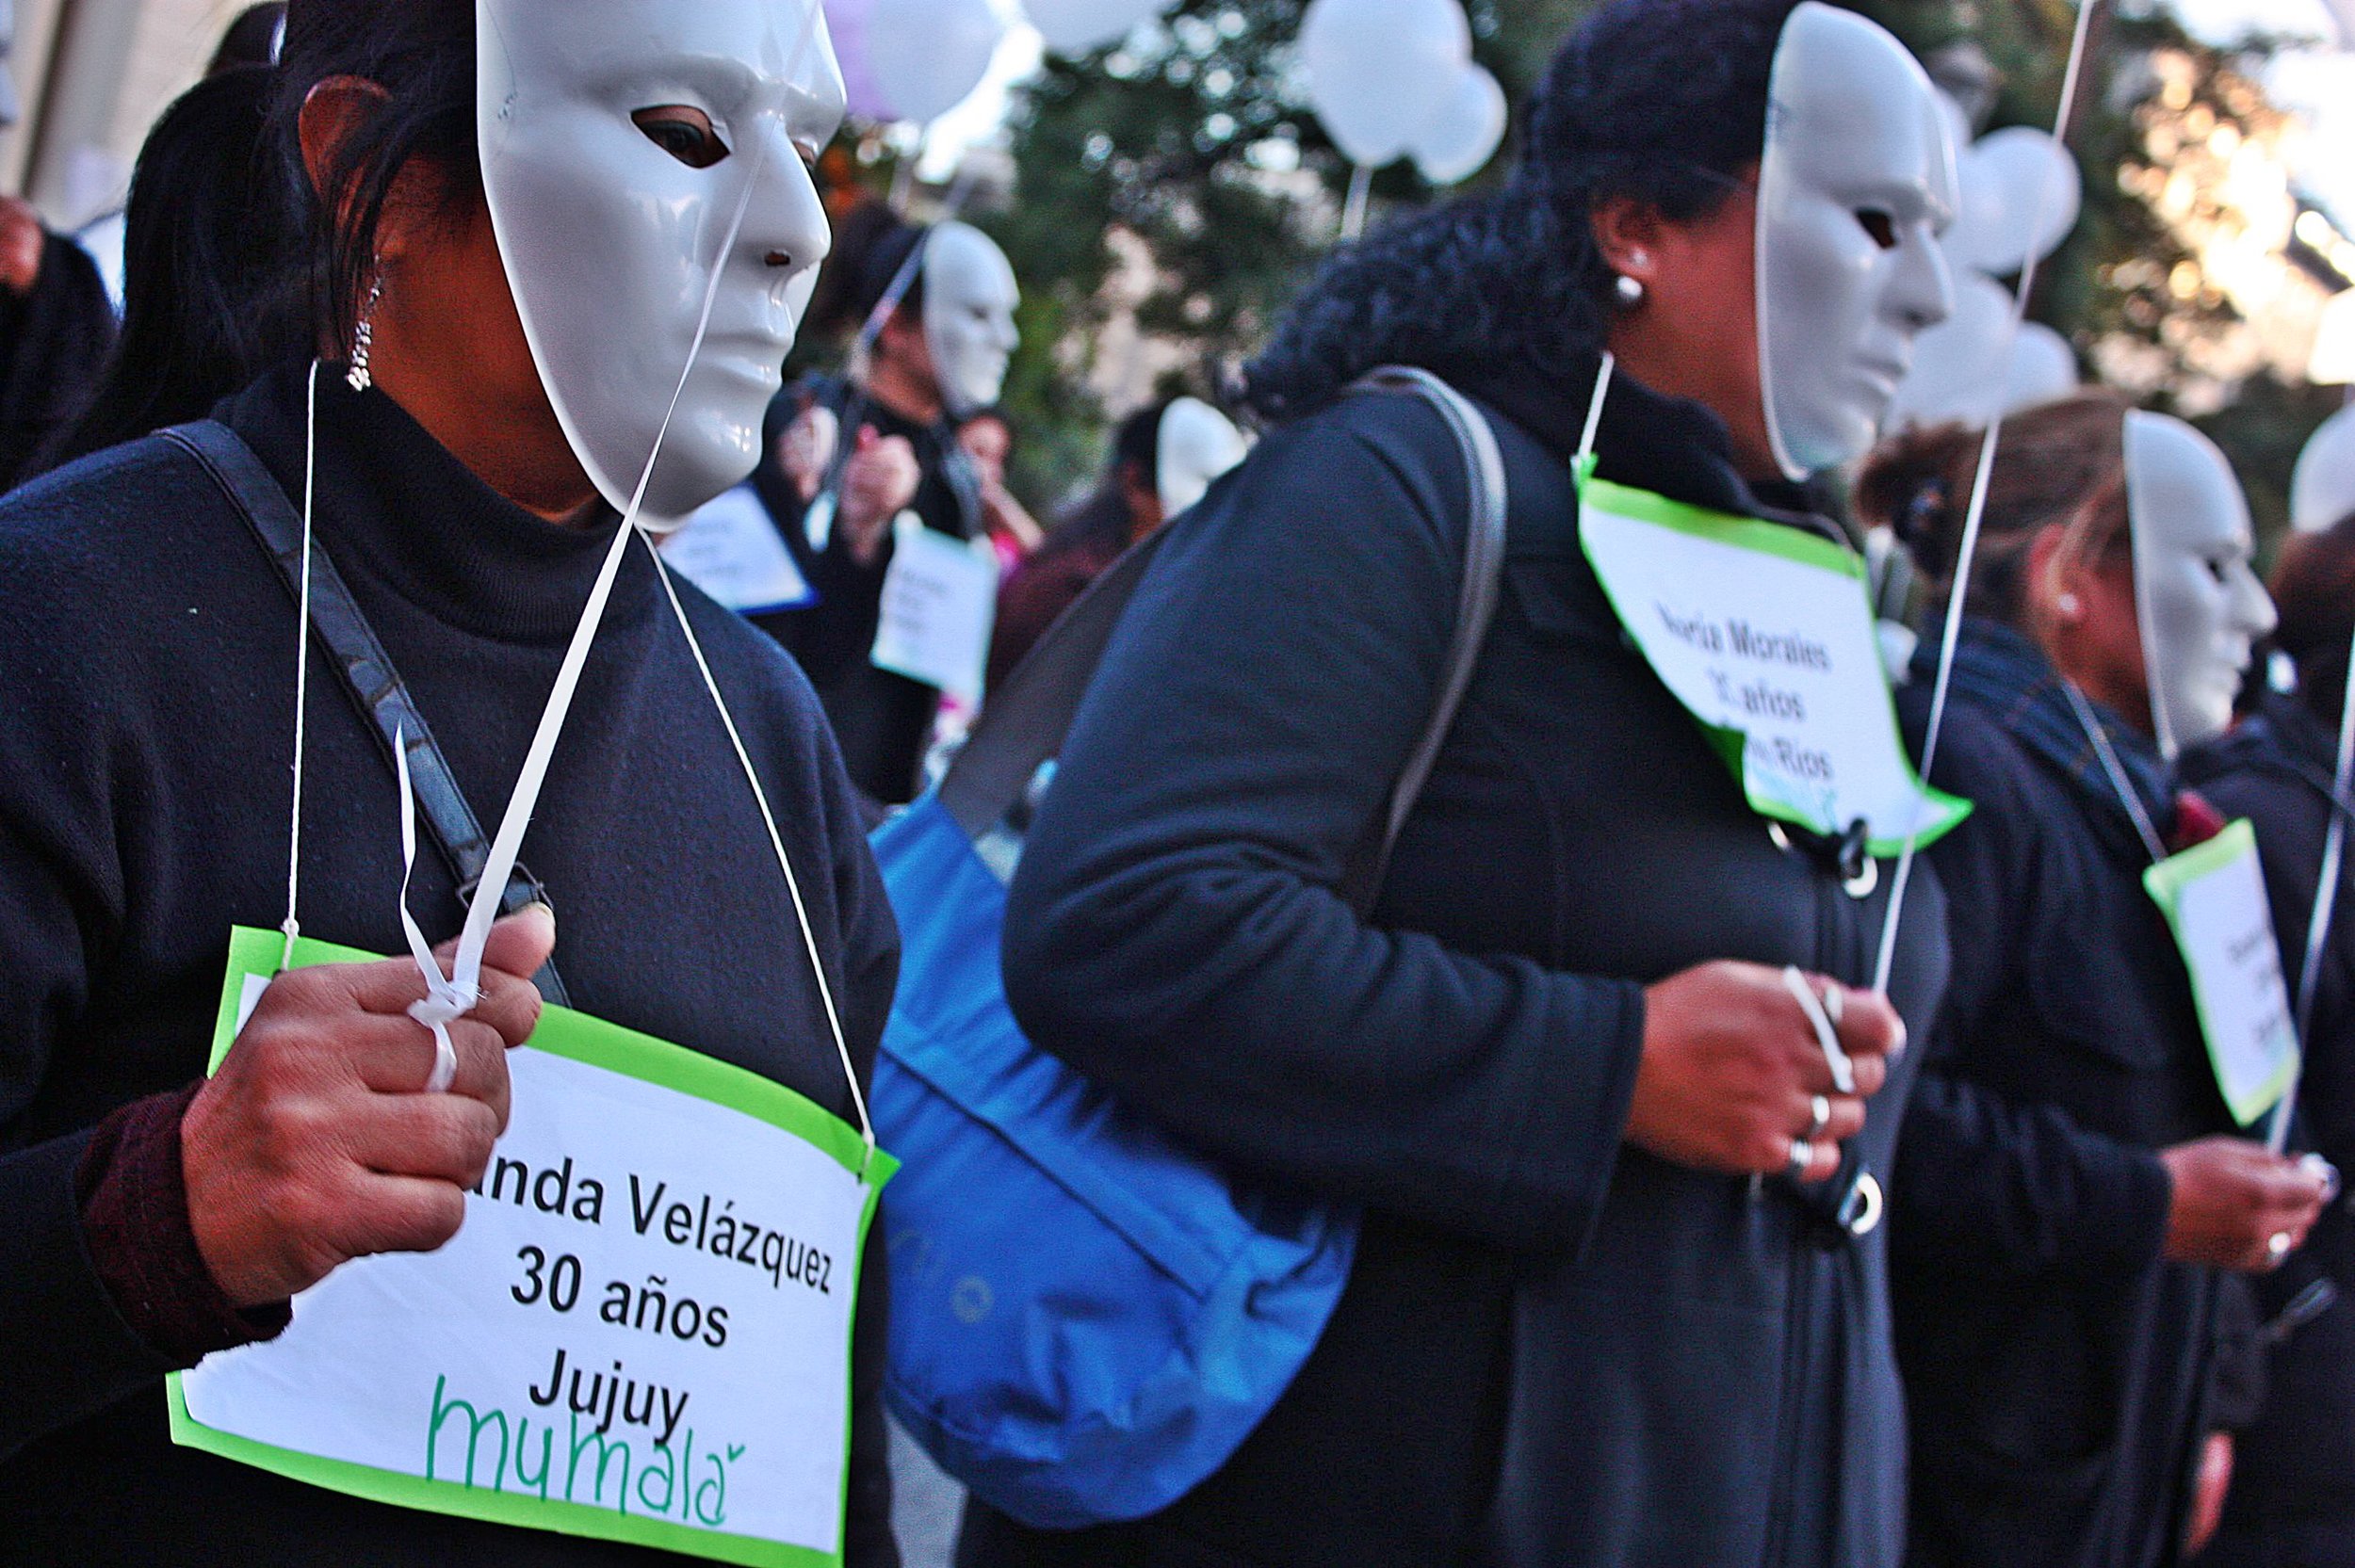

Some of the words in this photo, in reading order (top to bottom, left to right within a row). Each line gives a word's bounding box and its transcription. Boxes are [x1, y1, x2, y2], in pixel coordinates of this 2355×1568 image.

[1726, 617, 1833, 673] Morales
[470, 1155, 606, 1225] nda
[628, 1172, 834, 1296] Velázquez
[510, 1244, 583, 1314] 30
[599, 1274, 730, 1349] años
[528, 1348, 690, 1448] Jujuy
